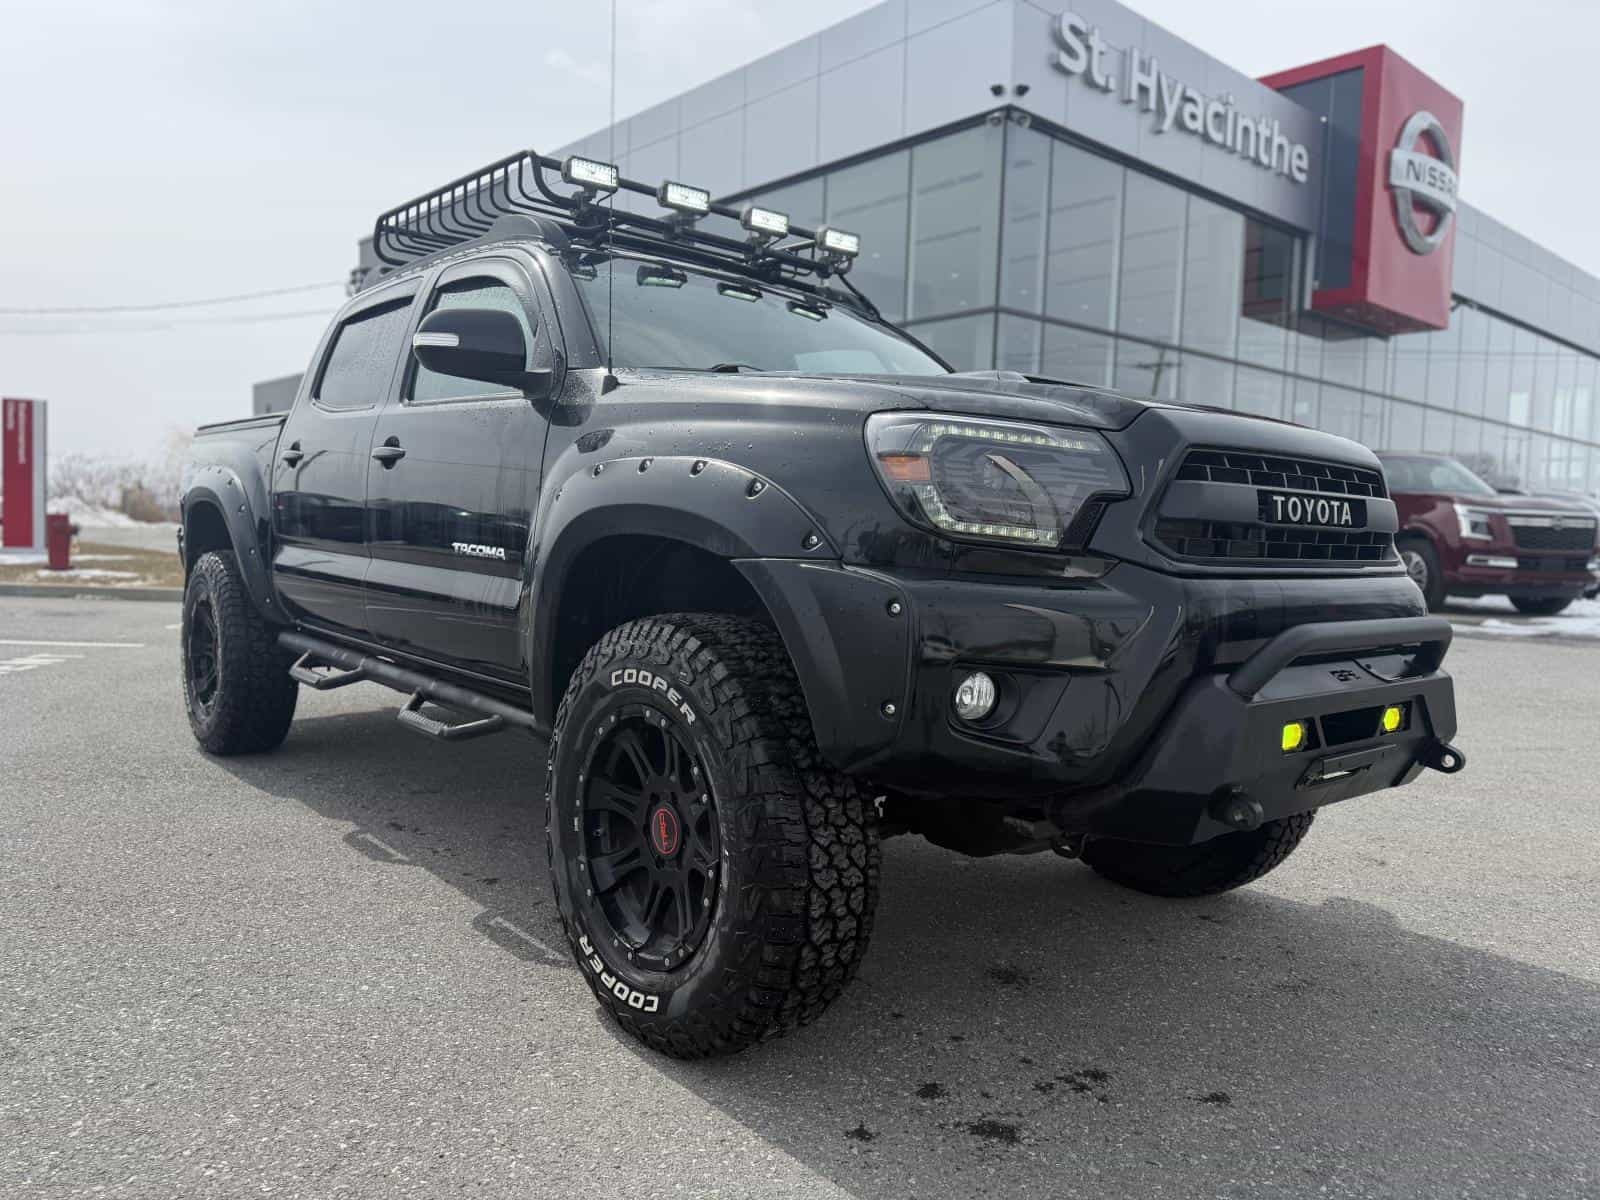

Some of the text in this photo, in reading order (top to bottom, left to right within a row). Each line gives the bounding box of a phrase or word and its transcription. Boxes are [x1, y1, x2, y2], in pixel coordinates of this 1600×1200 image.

[1053, 11, 1309, 182] St. Hyacinthe
[1272, 495, 1352, 525] TOYOTA
[451, 542, 506, 560] TACOMA
[611, 668, 696, 725] COOPER
[579, 934, 659, 1012] COOPER
